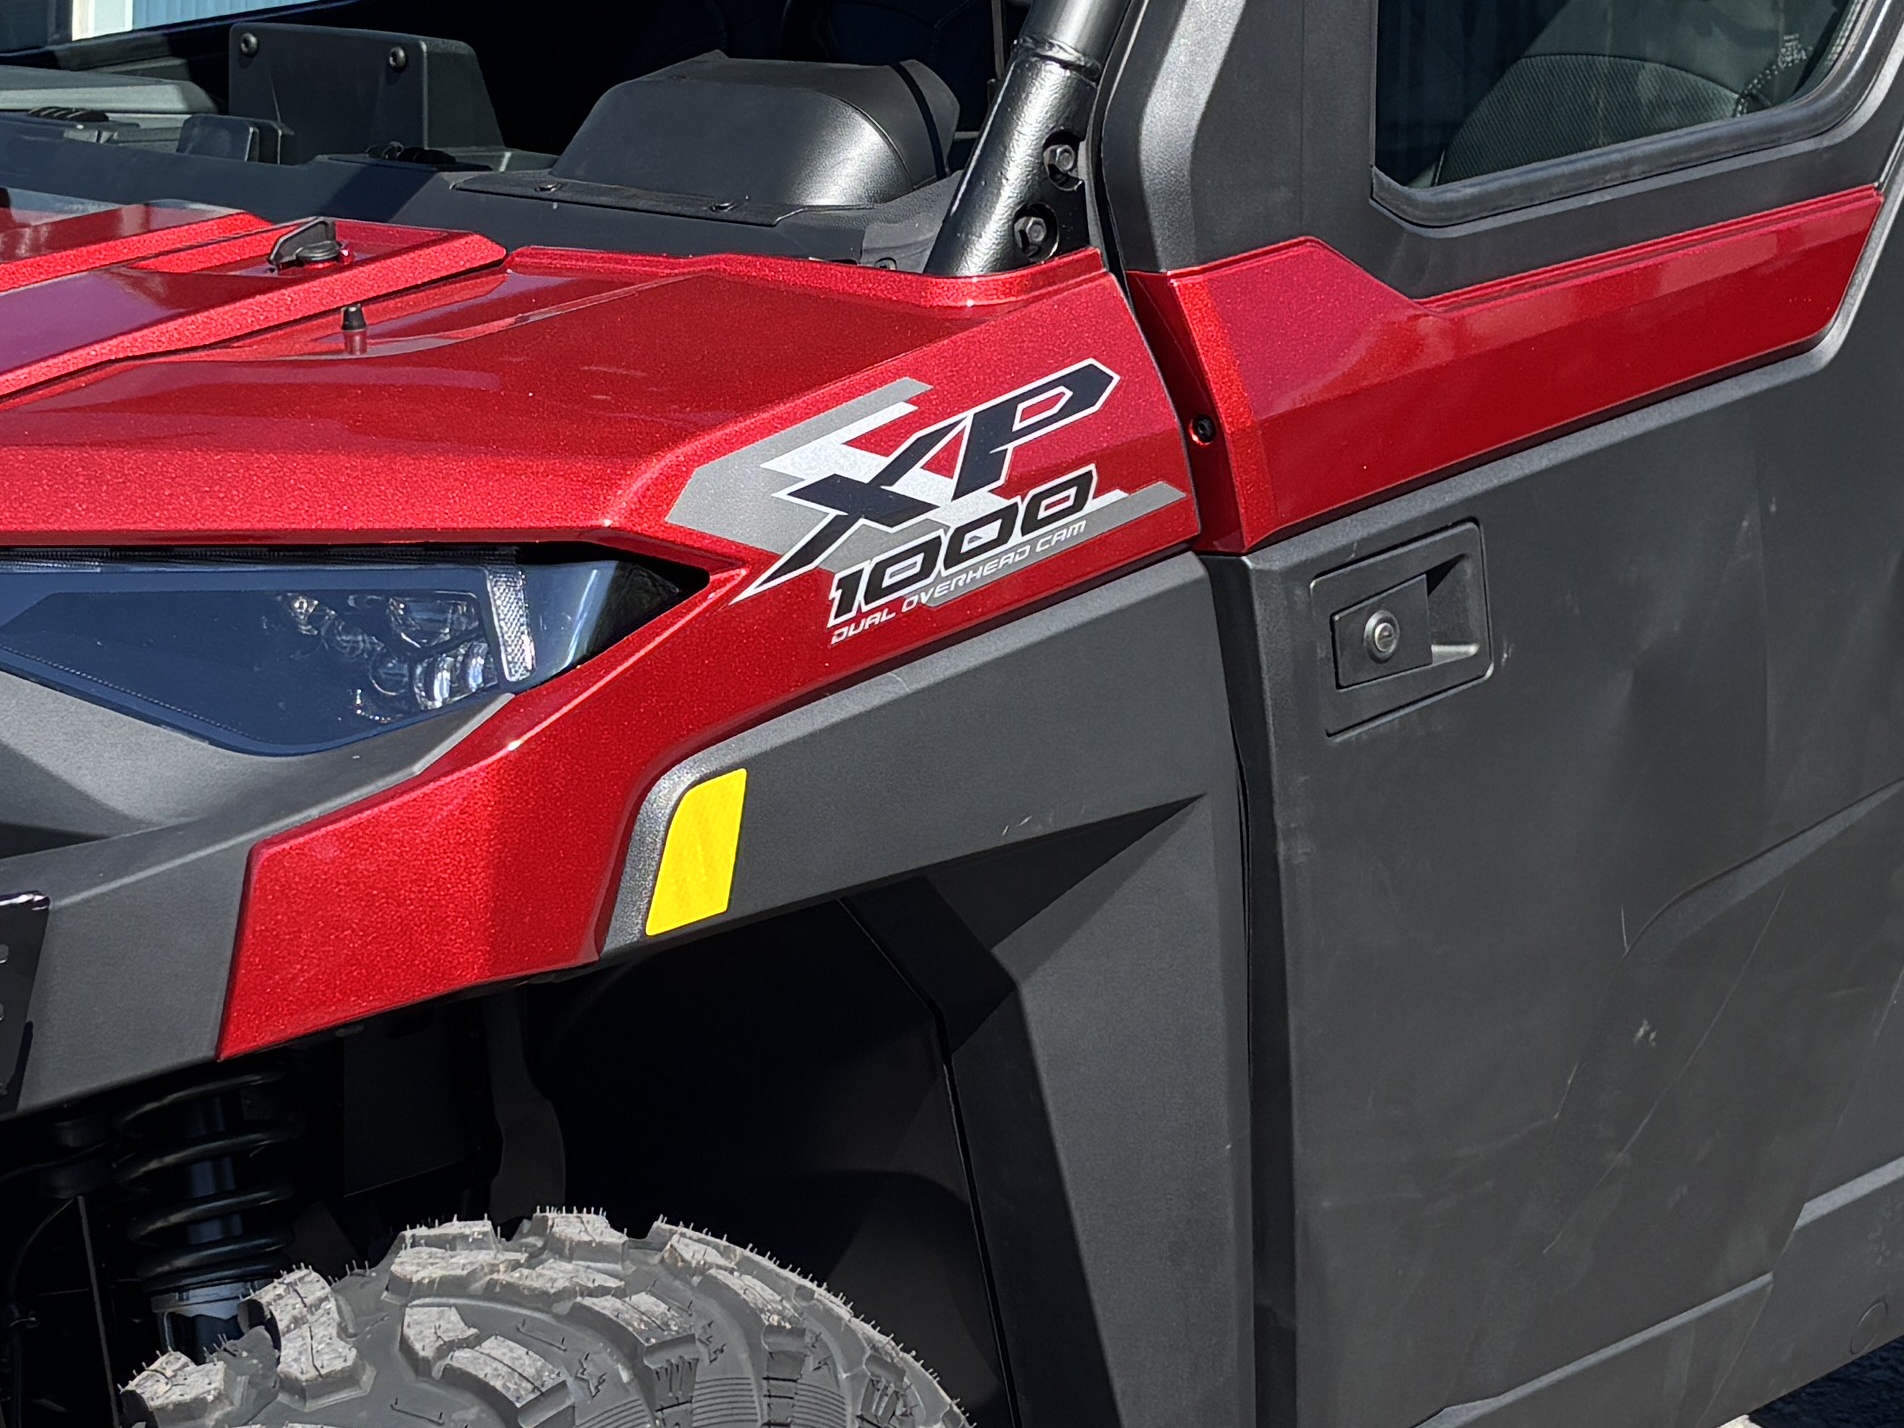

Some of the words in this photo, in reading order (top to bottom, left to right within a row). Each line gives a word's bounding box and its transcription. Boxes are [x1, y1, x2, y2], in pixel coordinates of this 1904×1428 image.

[730, 356, 1122, 605] XP
[827, 469, 1099, 630] 1000
[829, 606, 898, 646] DUAL
[902, 544, 1030, 612] OVERHEAD
[1034, 519, 1088, 558] CAM
